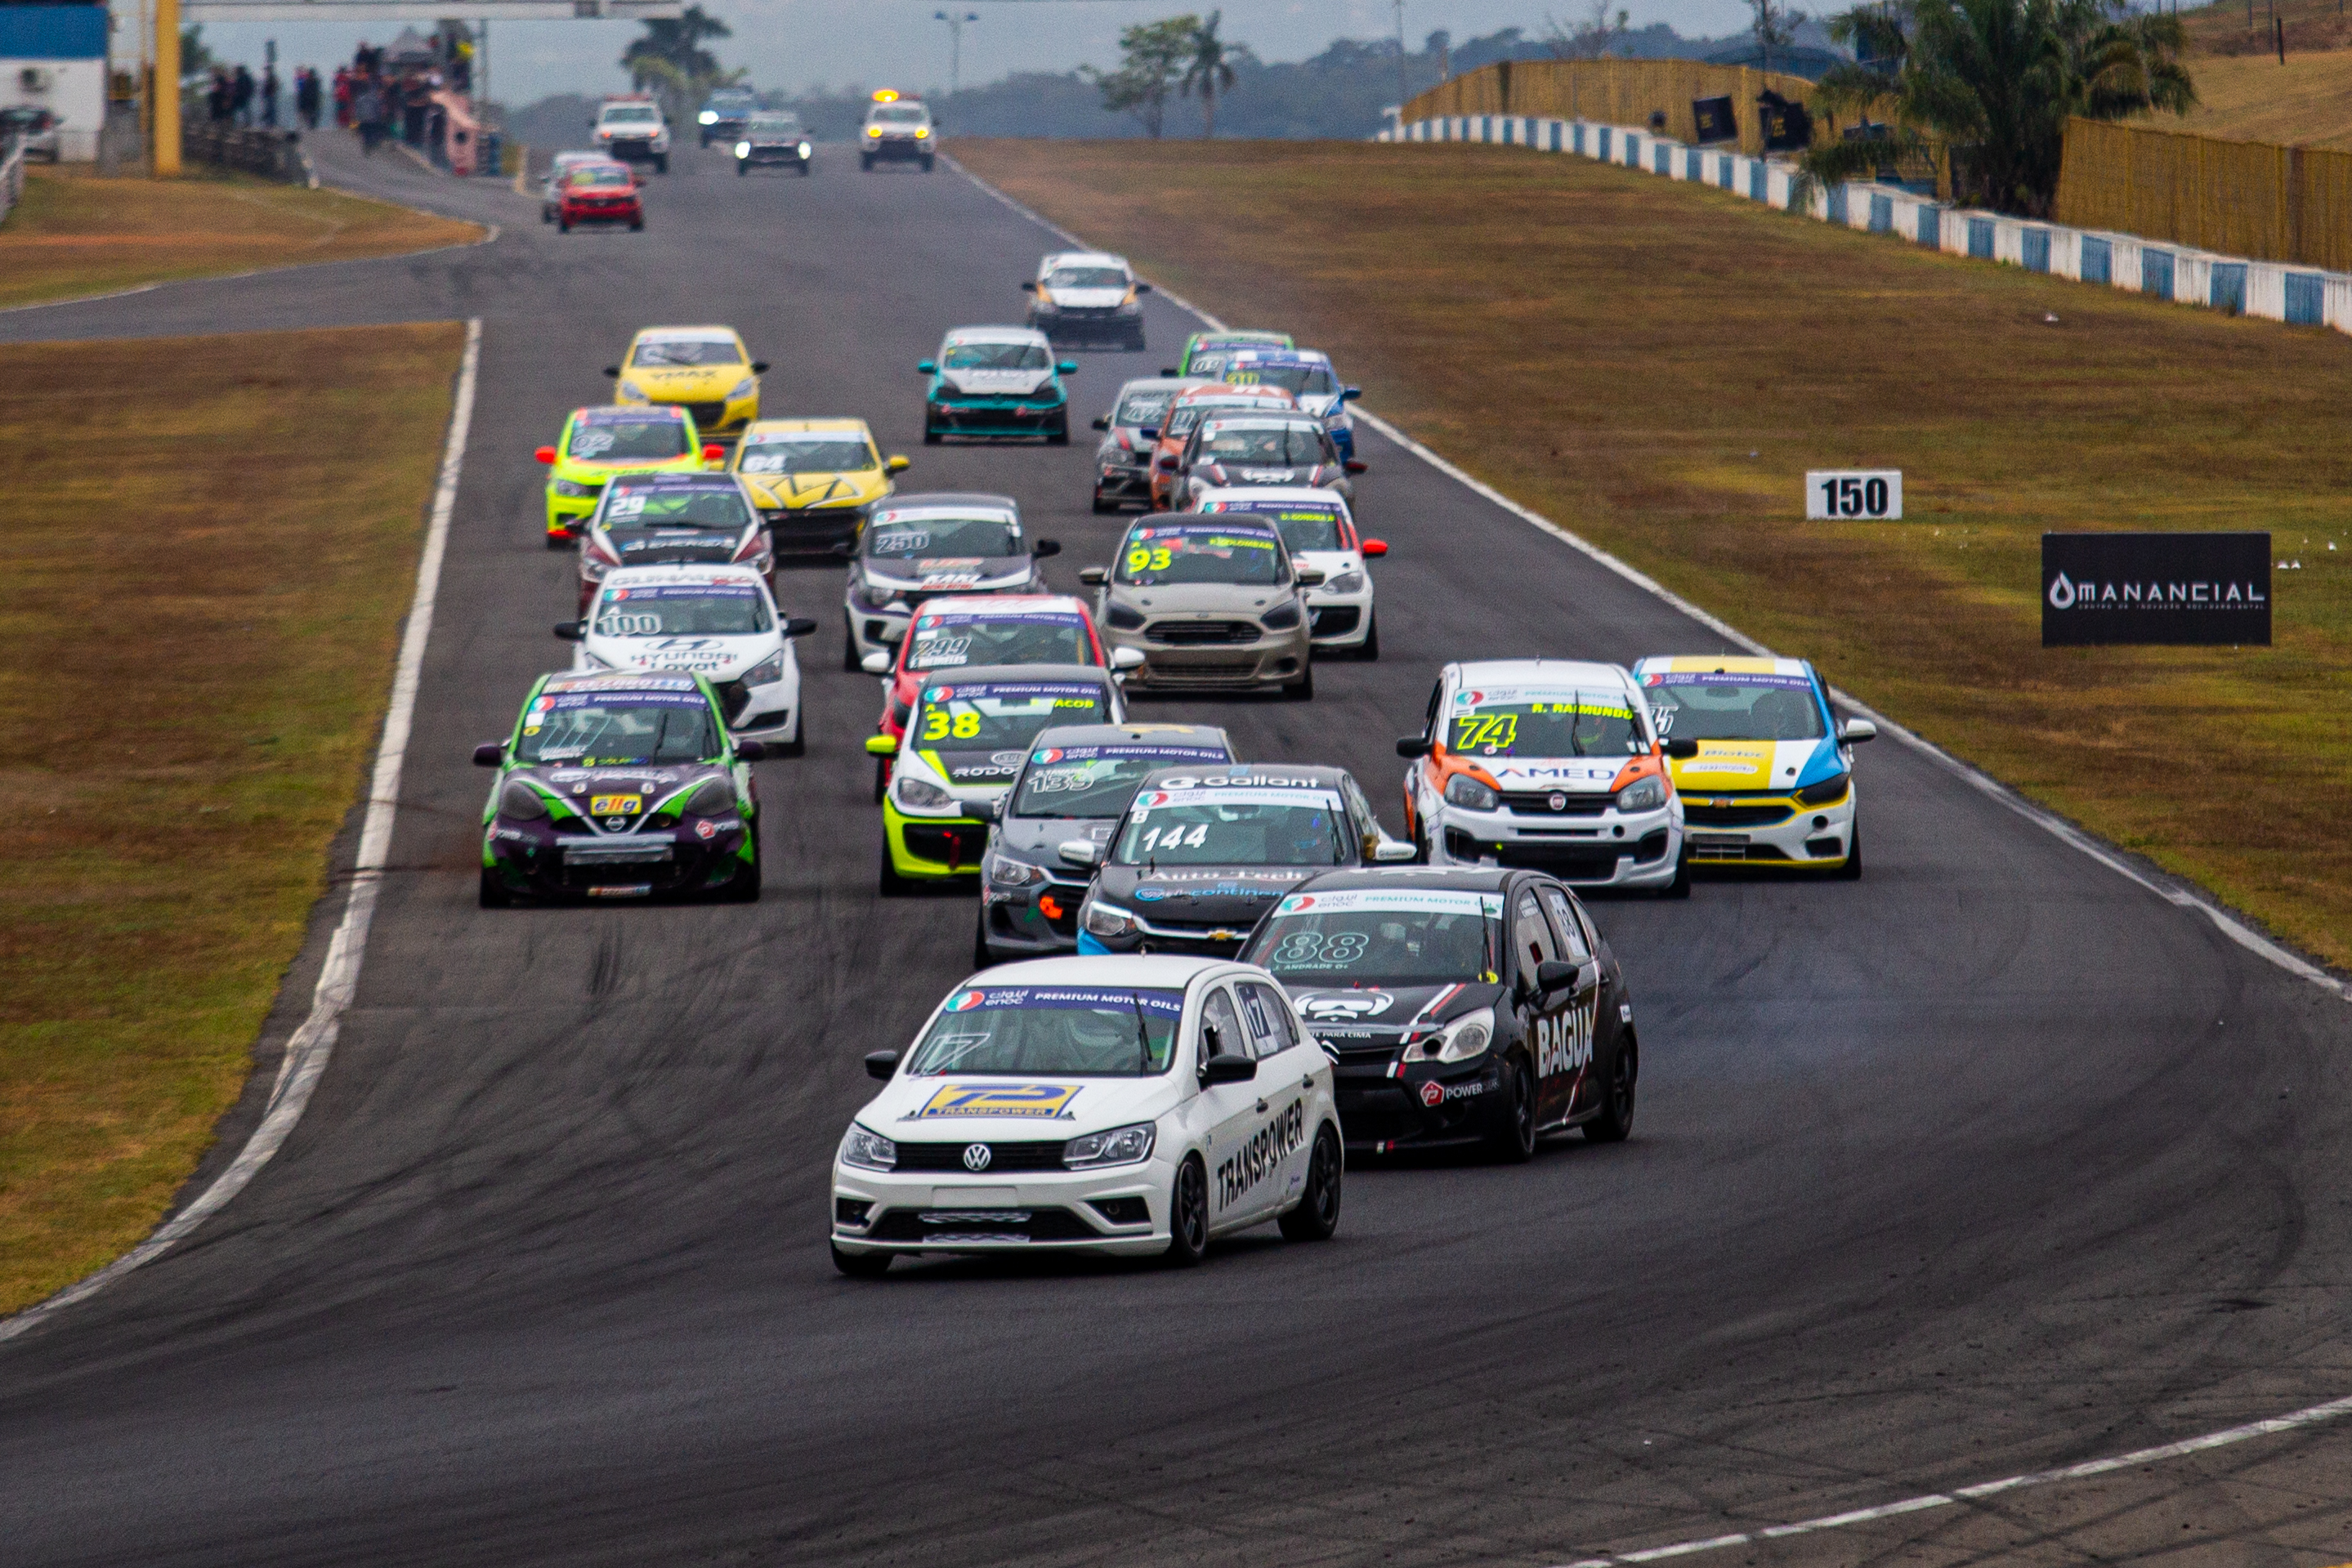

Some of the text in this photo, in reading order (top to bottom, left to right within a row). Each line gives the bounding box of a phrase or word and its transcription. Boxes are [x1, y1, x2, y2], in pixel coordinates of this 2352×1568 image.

[609, 496, 646, 517] 29
[1821, 477, 1889, 516] 150
[876, 532, 930, 554] 250
[1128, 547, 1172, 573] 93
[2078, 582, 2265, 601] MANANCIAL
[597, 614, 663, 636] 100
[631, 652, 738, 662] HYUNDAI
[913, 636, 973, 658] 299
[993, 686, 1041, 694] PREMIUM
[1043, 686, 1079, 695] MOTOR
[1553, 704, 1633, 720] RAIMUNDO
[923, 711, 981, 740] 38
[1456, 714, 1518, 750] 74
[1200, 751, 1225, 760] OILS
[1204, 775, 1320, 788] Gallant
[1270, 792, 1310, 800] MOTOR
[1131, 810, 1150, 824] B
[1142, 824, 1210, 852] 144
[1318, 900, 1354, 908] enoc
[1428, 897, 1471, 906] MOTOR
[1556, 908, 1576, 939] 88
[1273, 931, 1370, 963] 88
[985, 997, 1025, 1007] enoc
[1035, 991, 1183, 1012] PREMIUM MOTOR OILS
[1245, 998, 1265, 1038] 17
[1537, 1005, 1594, 1079] BAGUA
[1446, 1083, 1483, 1100] POWER
[937, 1107, 1047, 1117] TRANSPOWER
[1218, 1097, 1304, 1213] TRANSPOWER
